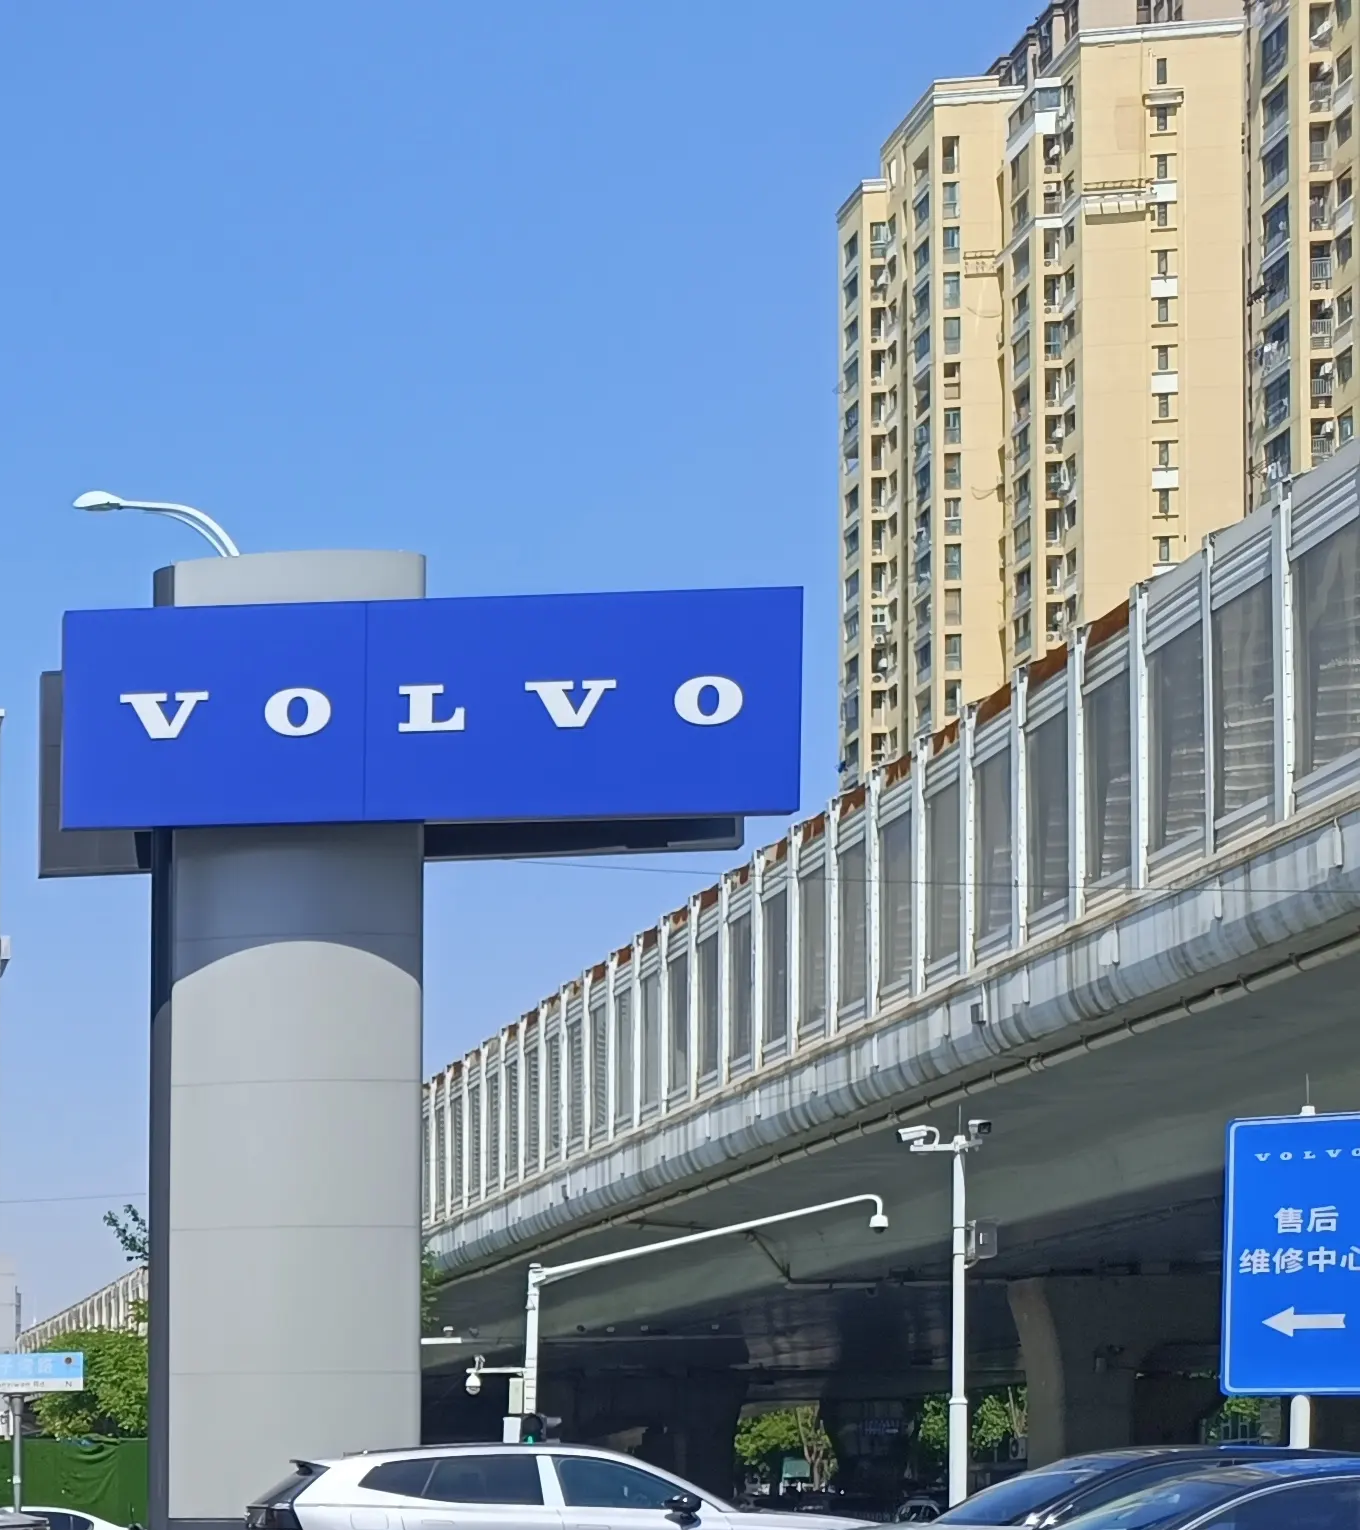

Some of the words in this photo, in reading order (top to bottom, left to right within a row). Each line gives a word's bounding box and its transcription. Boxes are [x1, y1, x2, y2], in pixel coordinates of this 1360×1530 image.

[119, 675, 744, 740] VOLVO
[1253, 1146, 1360, 1162] VOLVO
[1273, 1205, 1339, 1234] 售后
[1238, 1245, 1360, 1275] 维修中心
